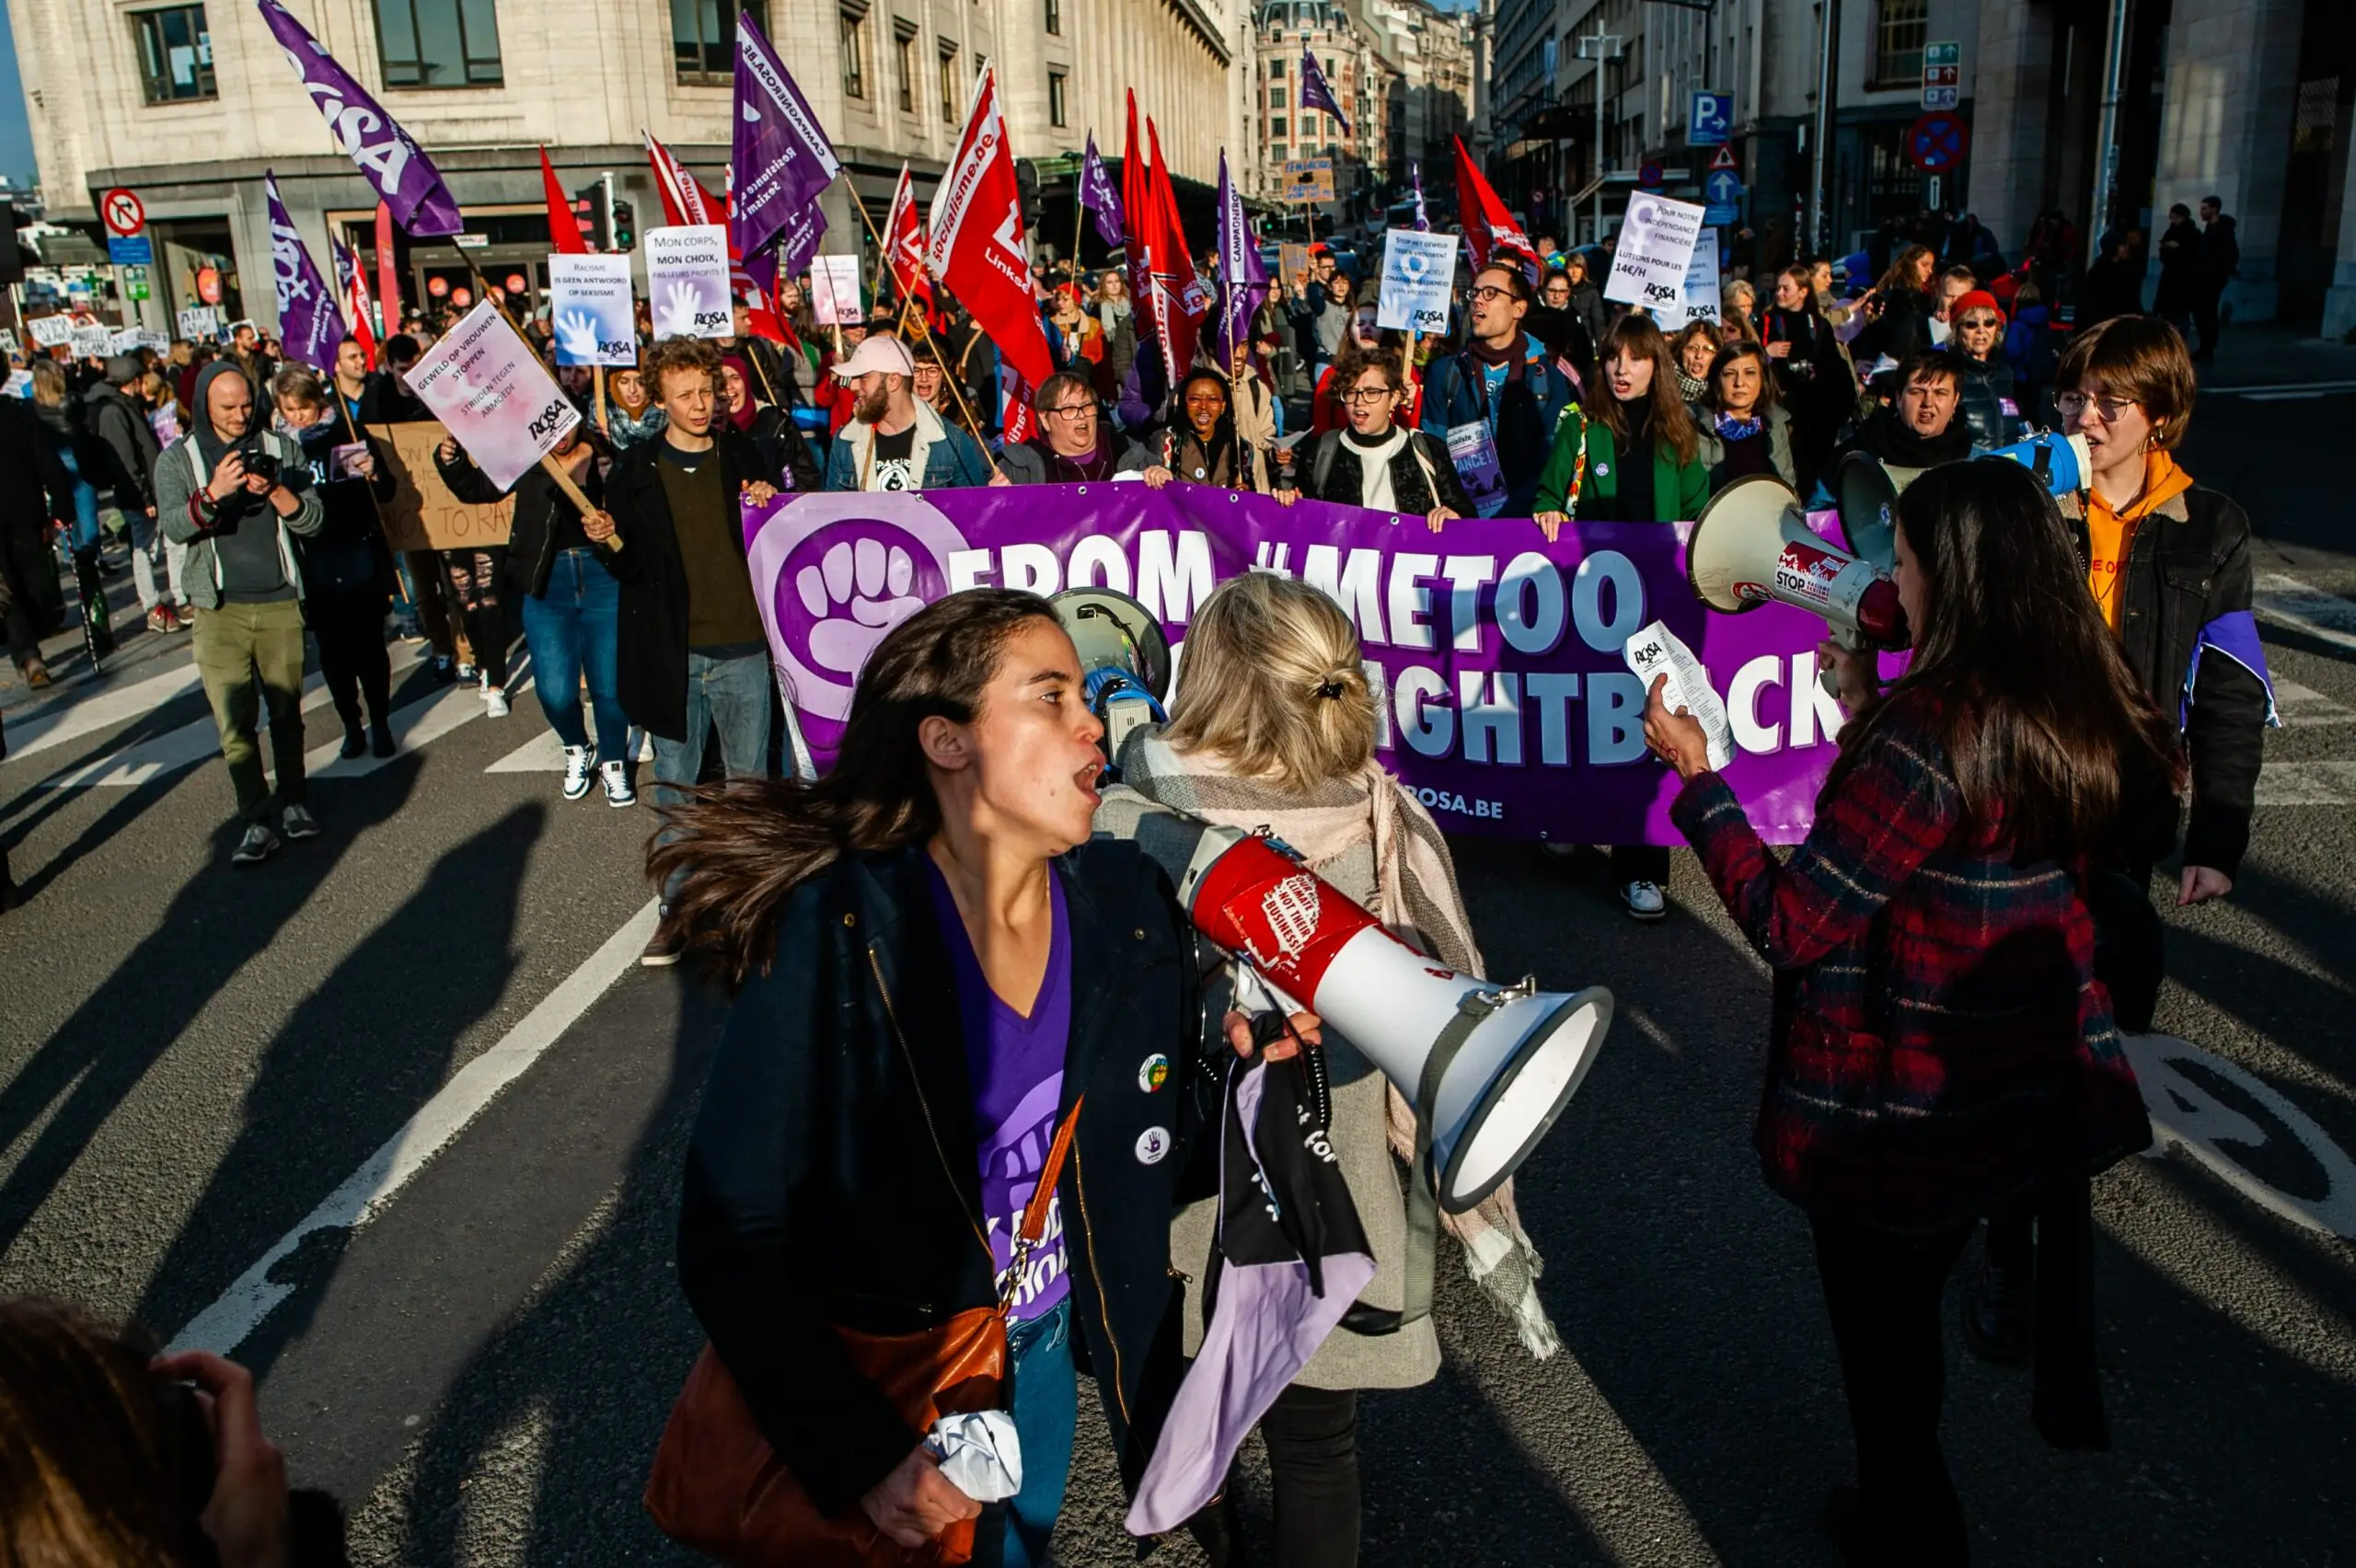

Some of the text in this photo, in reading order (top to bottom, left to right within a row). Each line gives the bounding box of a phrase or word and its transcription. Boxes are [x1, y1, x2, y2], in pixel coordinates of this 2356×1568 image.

[1696, 97, 1717, 128] P
[933, 133, 994, 263] socialisme.be
[1657, 206, 1699, 223] POUR NOTRE
[654, 236, 719, 248] MON CORPS,
[573, 263, 606, 271] RACISME
[657, 254, 719, 265] MON CHOIX,
[985, 247, 1029, 295] Linkse
[1615, 262, 1646, 278] 14€/H
[1619, 250, 1682, 271] LUTTONS POUR LES
[1645, 282, 1676, 302] ROSA
[694, 311, 729, 329] ROSA
[1414, 309, 1444, 324] ROSA
[1686, 305, 1716, 320] ROSA
[418, 313, 497, 391] GEWELD OP VROUWEN
[597, 340, 632, 358] ROSA
[452, 347, 486, 382] STOPPEN
[460, 361, 515, 416] STRIJDEN TEGEN
[480, 382, 516, 419] ARMOEDE
[527, 398, 568, 441] ROSA
[438, 506, 468, 537] TO
[947, 530, 1215, 623] FROM
[1776, 571, 1805, 591] STOP
[1634, 641, 1663, 664] ROSA
[1366, 650, 1846, 765] IGHTBCK
[1286, 880, 1314, 911] CLIMATE
[1296, 876, 1312, 892] OUR
[1265, 900, 1304, 951] BUSINESS!
[1279, 891, 1311, 938] NOT THEIR
